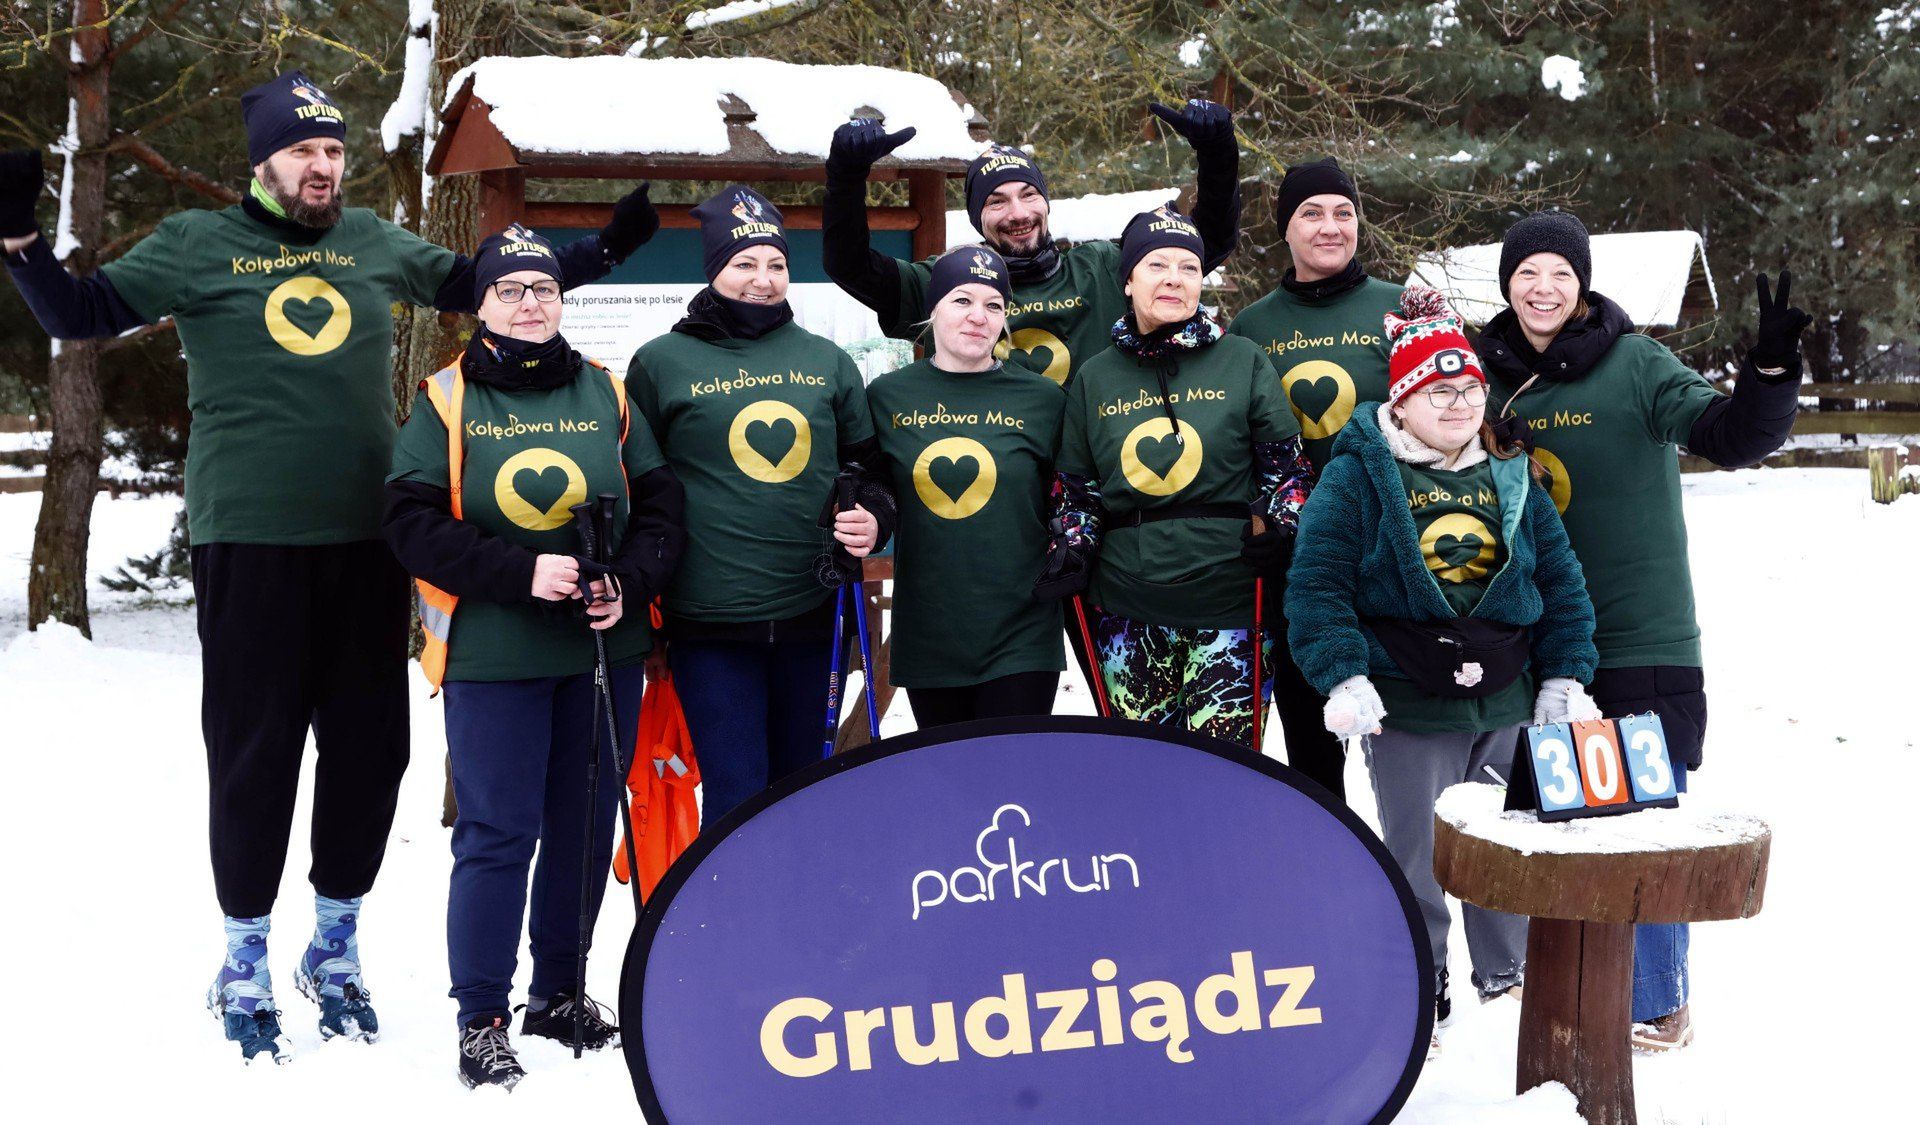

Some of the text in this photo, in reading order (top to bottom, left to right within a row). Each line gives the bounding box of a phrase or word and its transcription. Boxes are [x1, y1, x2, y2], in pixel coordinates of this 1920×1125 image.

[232, 244, 356, 274] Kolędowa Moc
[563, 294, 683, 307] ady poruszania się po lesie
[1004, 296, 1083, 317] dowa Moc
[1263, 330, 1381, 355] olędowa Moc
[691, 368, 826, 397] Kolędowa Moc
[1186, 387, 1226, 402] Moc
[465, 413, 599, 440] Kolędowa Moc
[893, 402, 1025, 429] Kolędowa Moc
[1554, 409, 1592, 428] Moc
[1537, 729, 1671, 805] 303
[911, 803, 1139, 920] parkrun
[759, 949, 1323, 1079] Grudziądz
